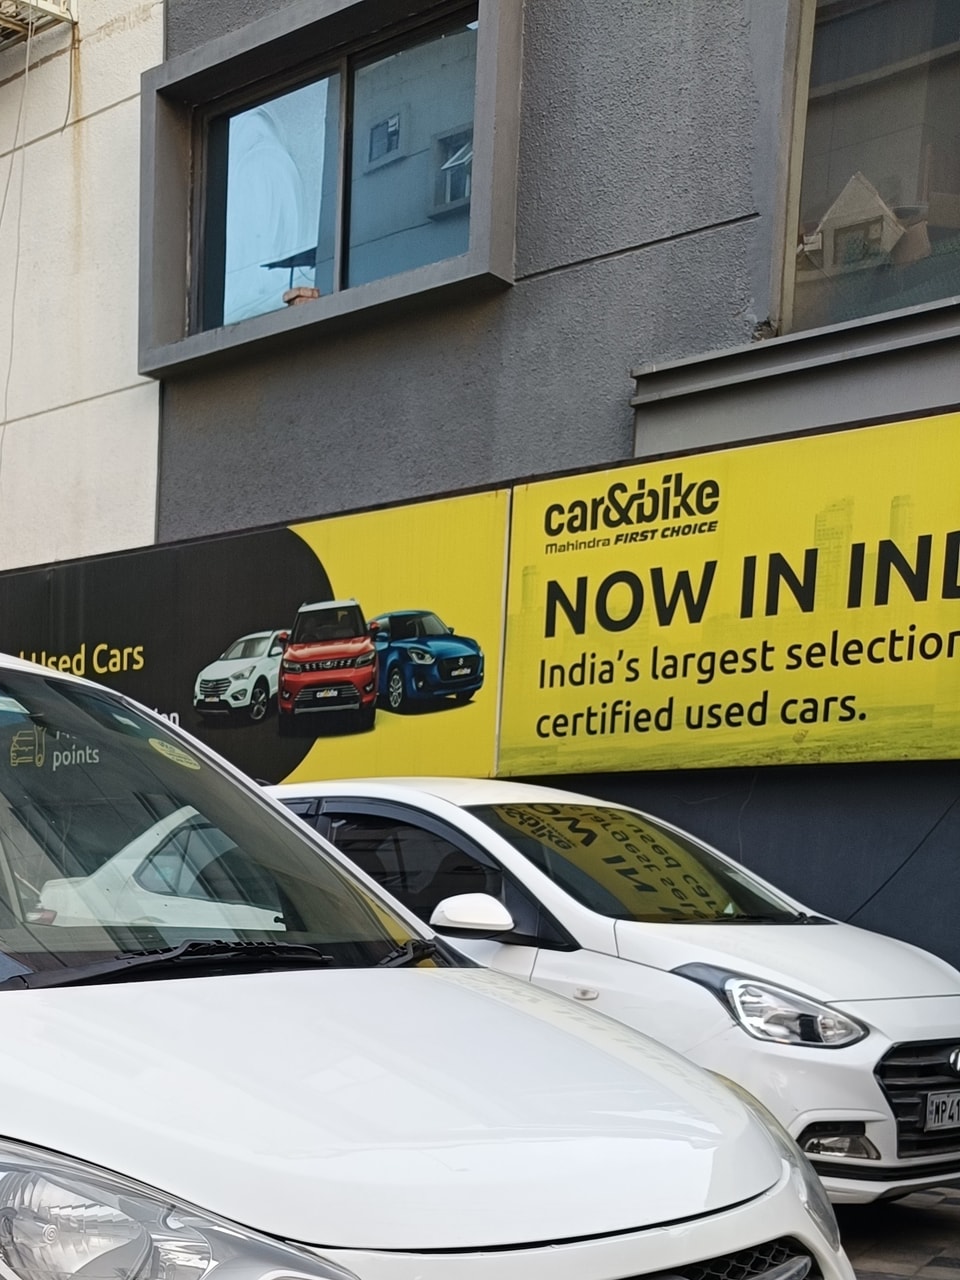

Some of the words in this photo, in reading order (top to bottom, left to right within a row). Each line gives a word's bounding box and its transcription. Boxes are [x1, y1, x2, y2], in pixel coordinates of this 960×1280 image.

[544, 472, 720, 537] car&bike
[545, 537, 611, 554] Mahindra
[614, 529, 659, 546] FIRST
[661, 520, 719, 538] CHOICE
[544, 560, 718, 638] NOW
[739, 548, 819, 619] IN
[93, 643, 145, 674] Cars
[651, 640, 775, 685] largest
[535, 696, 674, 739] certified
[685, 690, 769, 730] used
[780, 695, 867, 724] cars.
[53, 744, 100, 771] points
